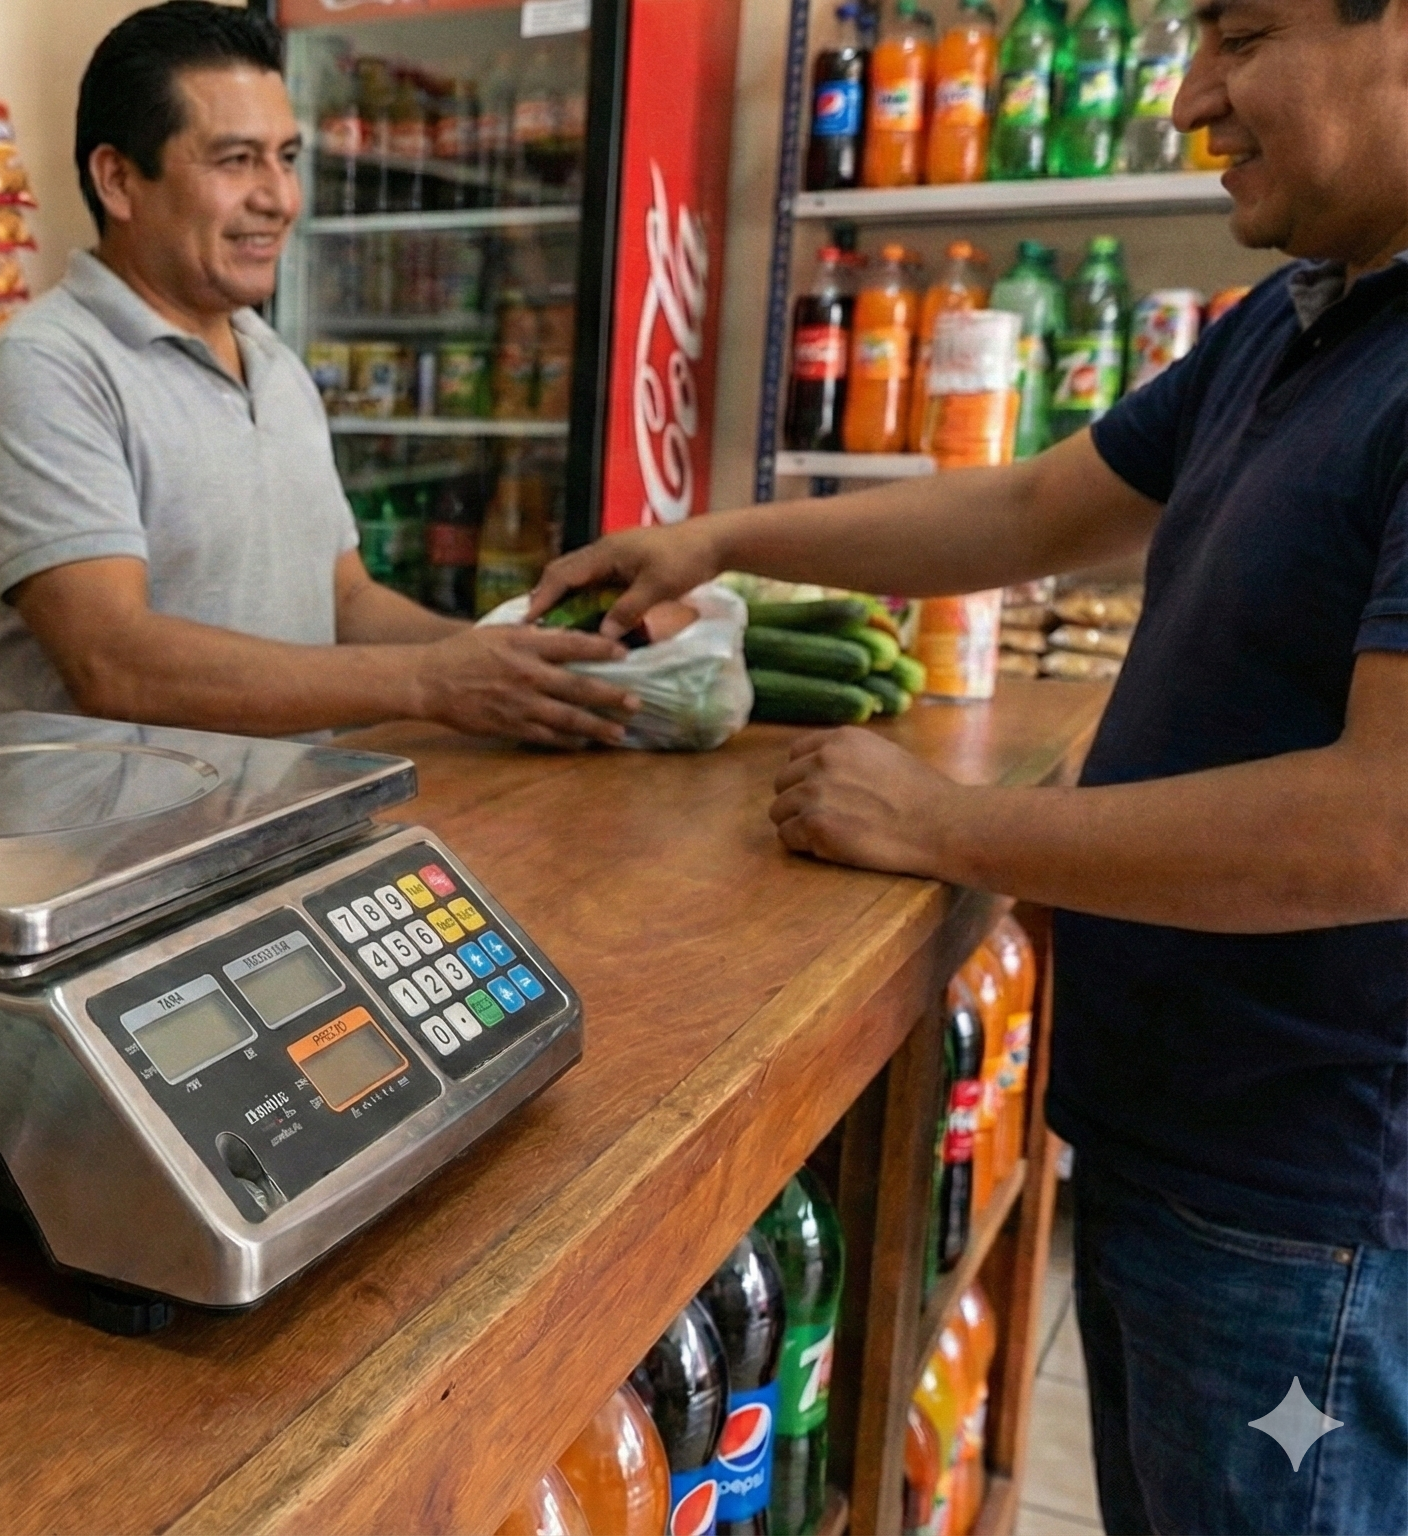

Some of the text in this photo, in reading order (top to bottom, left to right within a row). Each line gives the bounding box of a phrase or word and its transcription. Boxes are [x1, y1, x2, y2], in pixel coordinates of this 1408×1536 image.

[338, 893, 403, 933] 7 8 9
[372, 927, 433, 969] 4 5 6
[402, 962, 463, 1005] 1 2 3
[432, 1025, 450, 1045] 0
